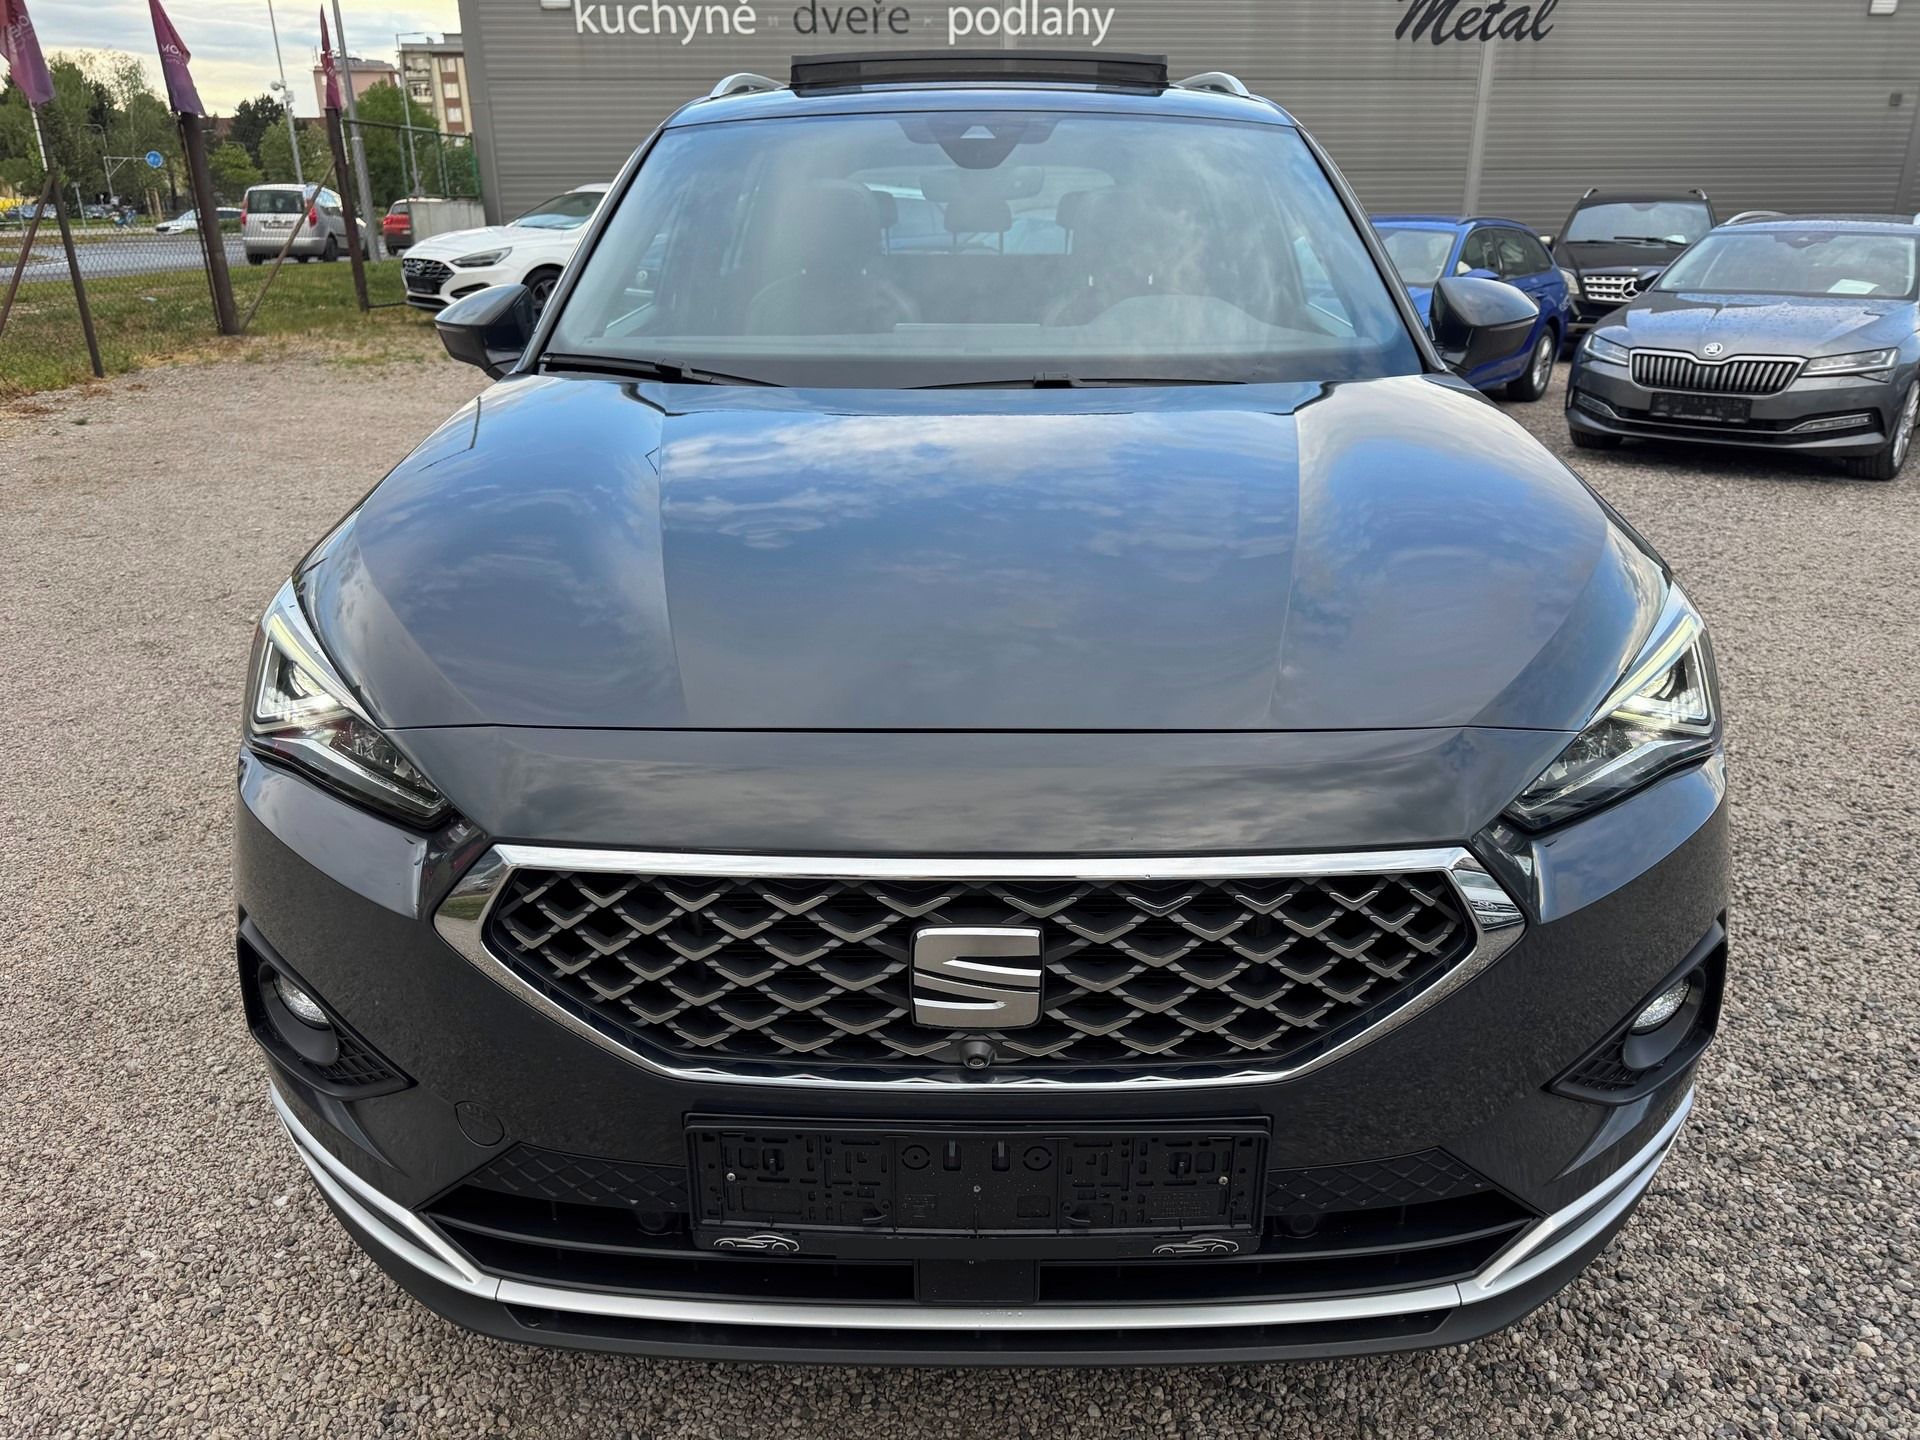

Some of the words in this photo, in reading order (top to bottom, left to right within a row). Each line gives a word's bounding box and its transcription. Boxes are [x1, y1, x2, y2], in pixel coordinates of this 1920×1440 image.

[574, 0, 757, 46] kuchyně
[792, 0, 911, 35] dveře
[948, 0, 1116, 47] podlahy
[1394, 0, 1560, 46] Metal
